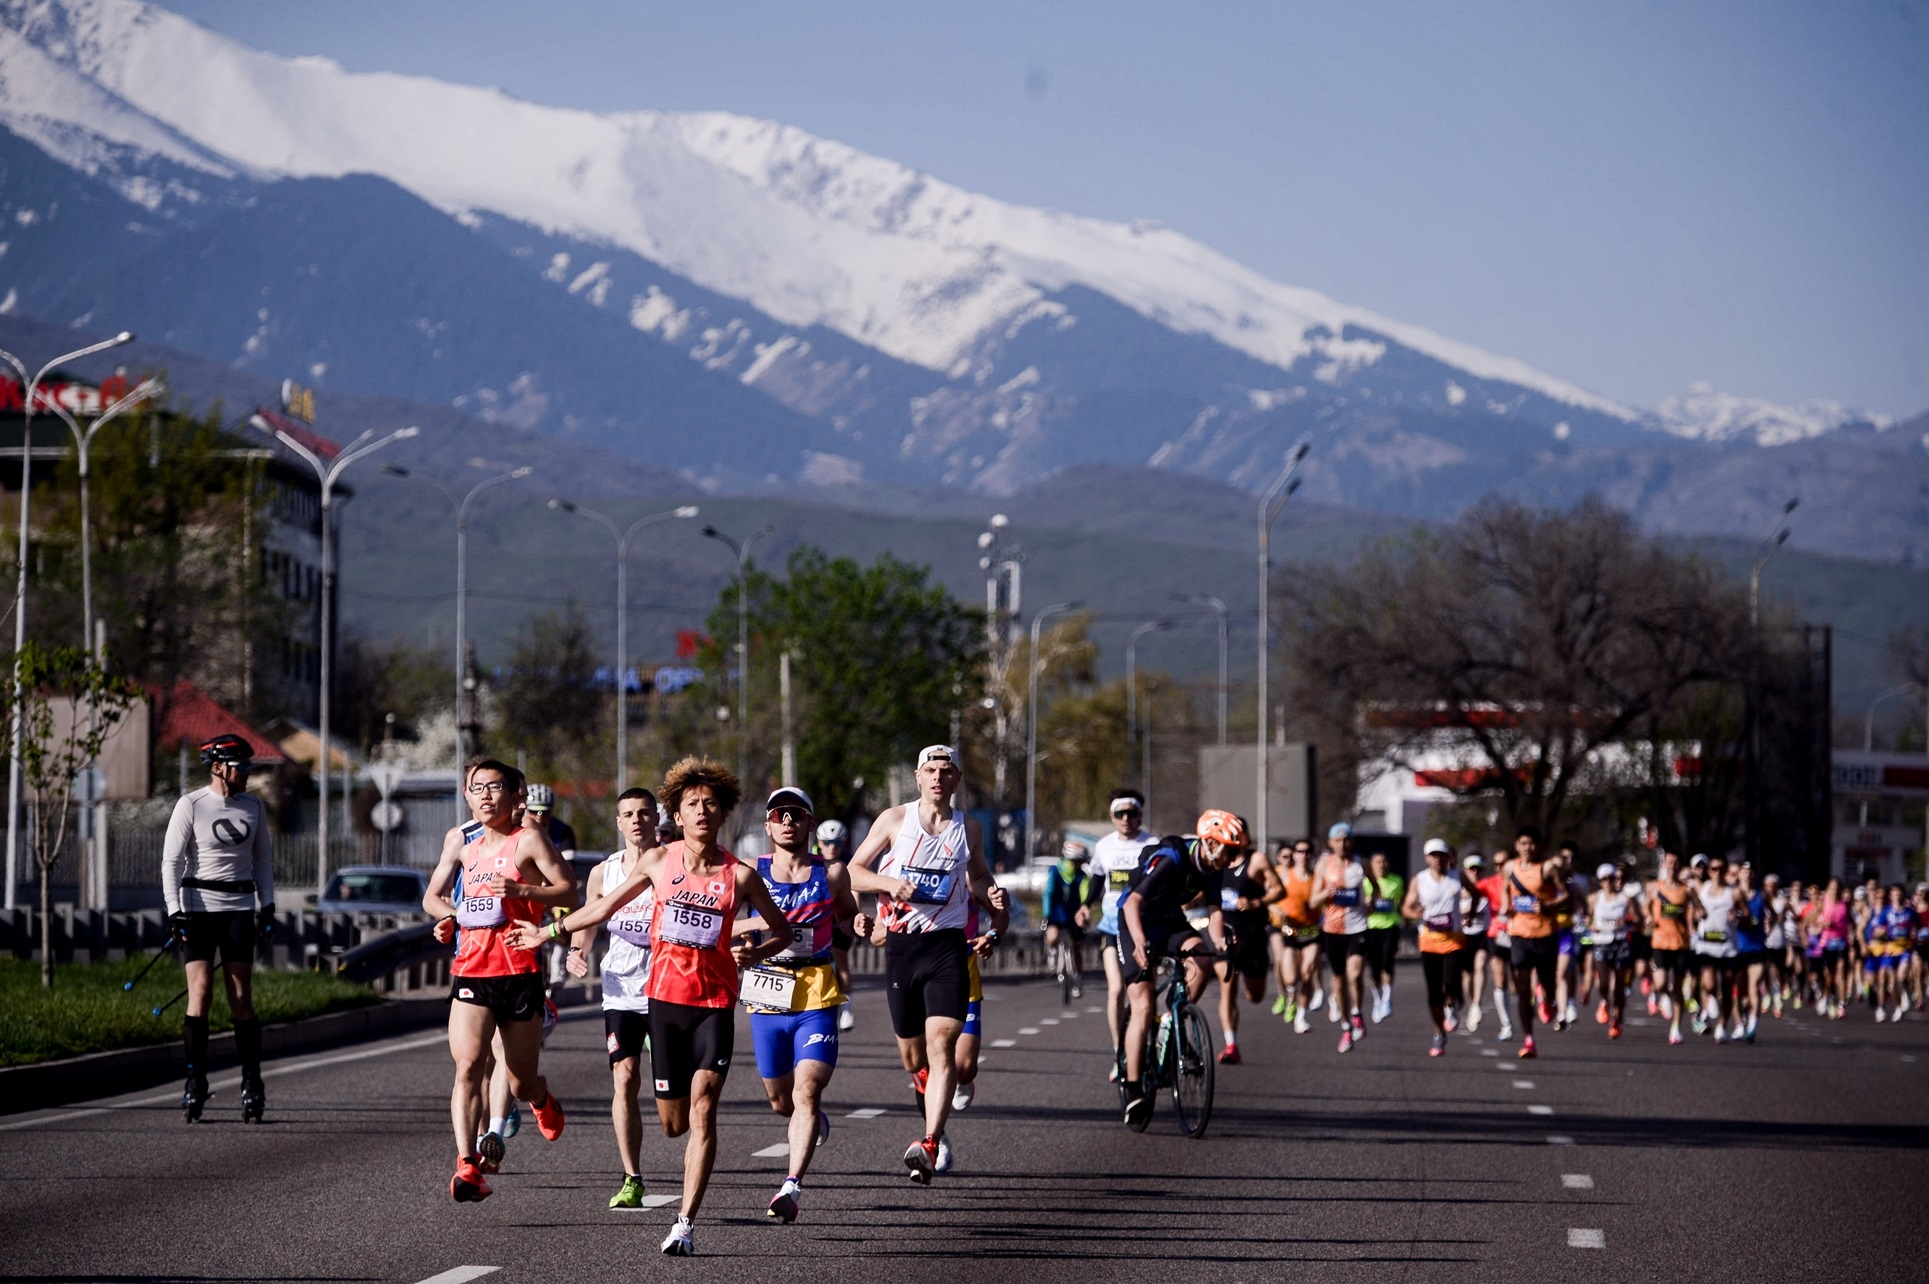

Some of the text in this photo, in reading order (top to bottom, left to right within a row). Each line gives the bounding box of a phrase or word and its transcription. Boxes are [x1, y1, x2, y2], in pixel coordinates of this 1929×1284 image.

[466, 898, 494, 913] 1559
[672, 890, 719, 907] JAPAN
[619, 920, 651, 934] 1557
[673, 909, 713, 929] 1558
[754, 974, 783, 992] 7715
